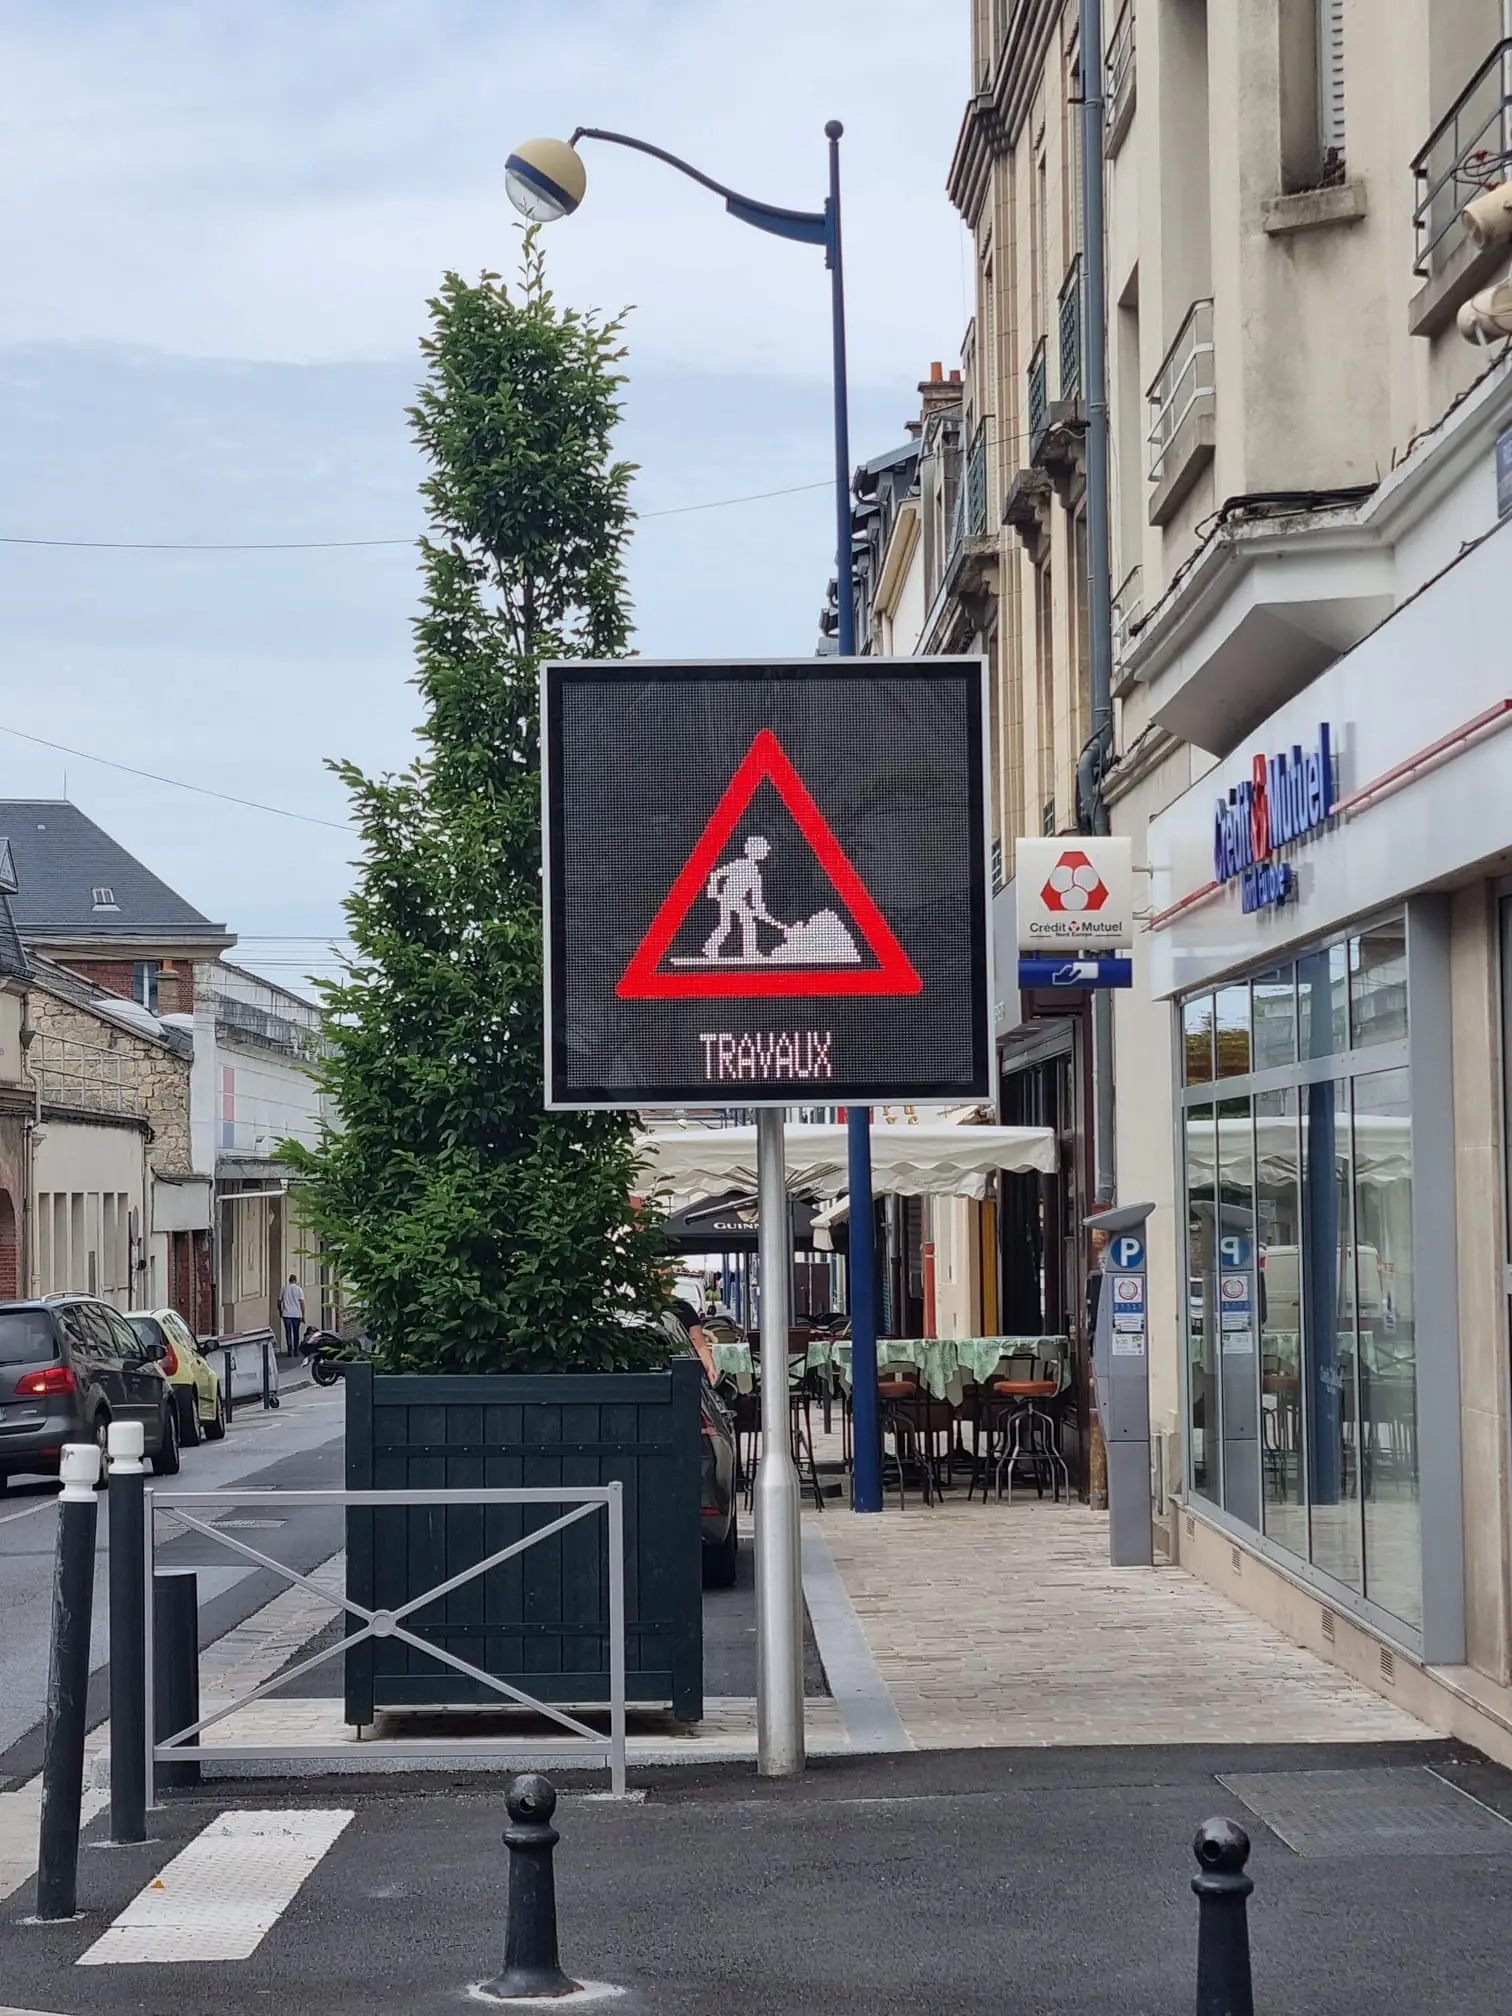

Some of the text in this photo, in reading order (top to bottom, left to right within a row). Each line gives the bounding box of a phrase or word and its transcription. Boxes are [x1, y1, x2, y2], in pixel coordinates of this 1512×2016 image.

[1214, 722, 1331, 884] Crédit Mutuel
[1029, 921, 1123, 933] Crédit Mutuel
[699, 1031, 832, 1079] TRAVAUX
[713, 1222, 760, 1230] GUINN
[1120, 1237, 1140, 1267] P
